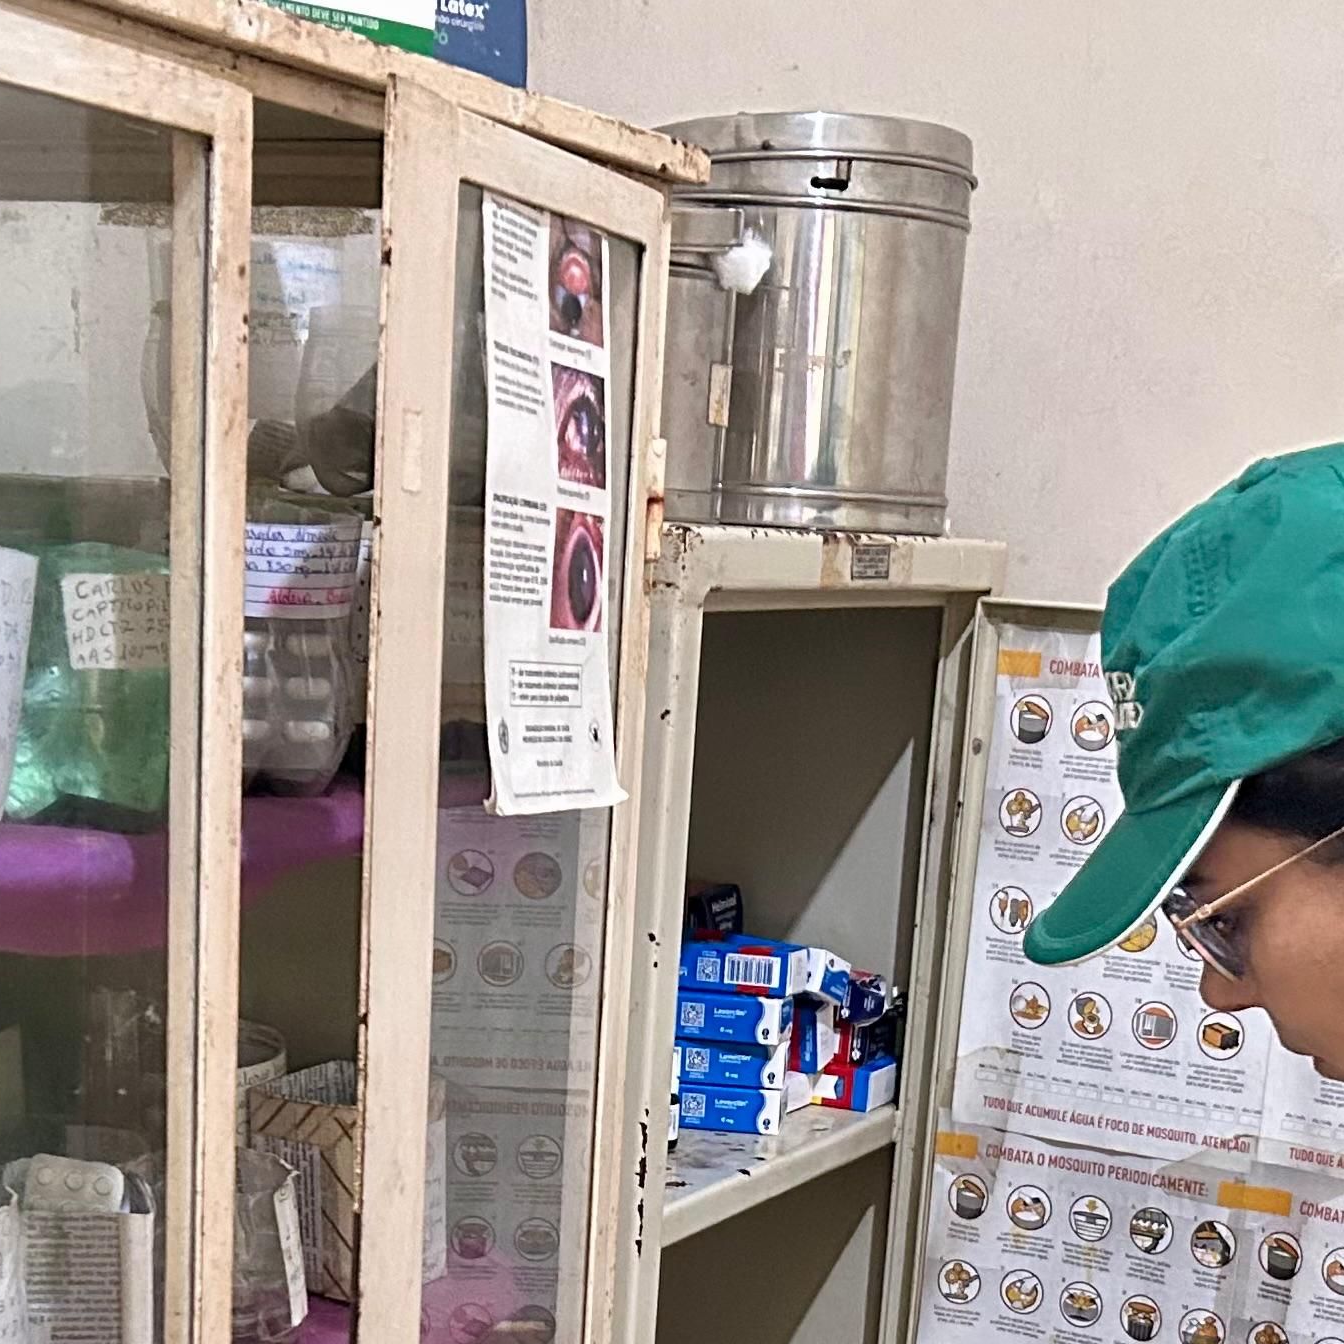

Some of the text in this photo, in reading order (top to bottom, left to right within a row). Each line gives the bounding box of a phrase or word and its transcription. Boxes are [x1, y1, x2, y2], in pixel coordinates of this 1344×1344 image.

[347, 14, 380, 30] MANTIDO
[1049, 659, 1100, 679] COMBATA
[983, 1094, 1251, 1155] TUDO QUE ACUMULE ÁGUA É FOCO DE MOSQUITO. ATENÇÃO!
[1289, 1146, 1314, 1163] TUDO
[1316, 1151, 1335, 1168] QUE
[985, 1144, 1209, 1197] COMBATA O MOSQUITO PERIODICAMENTE:
